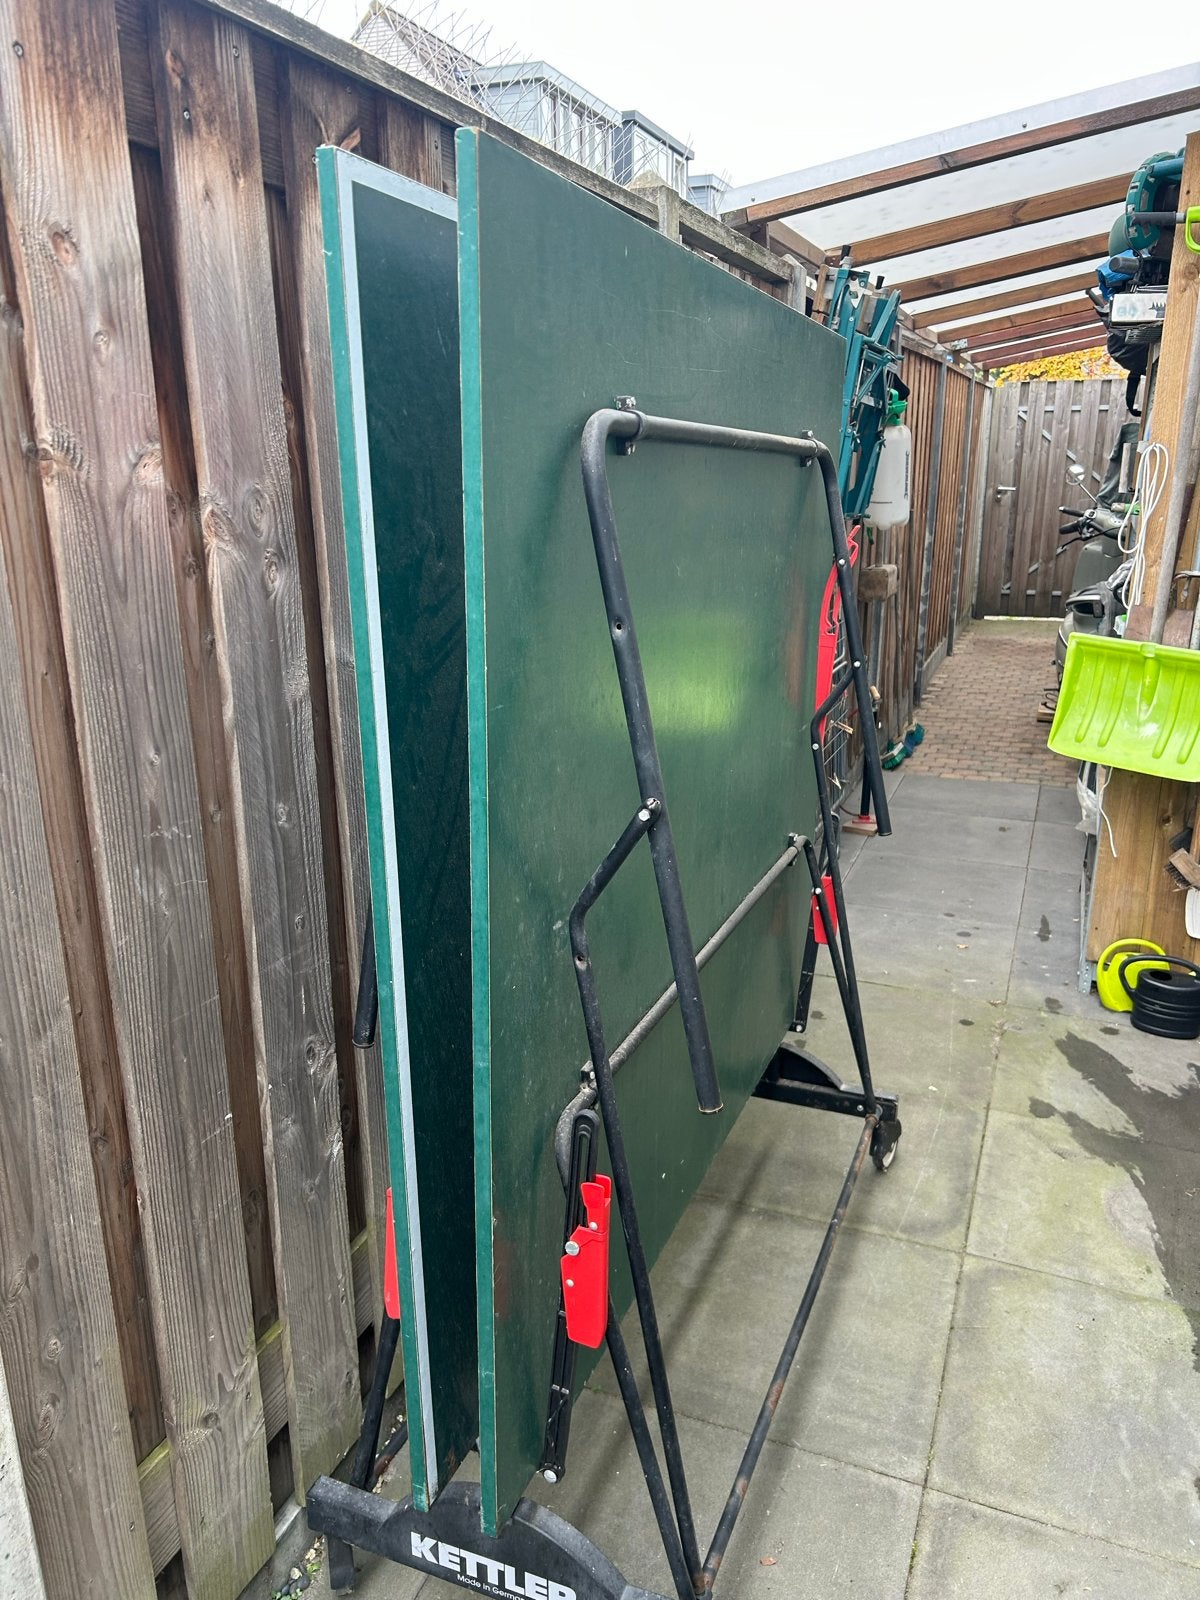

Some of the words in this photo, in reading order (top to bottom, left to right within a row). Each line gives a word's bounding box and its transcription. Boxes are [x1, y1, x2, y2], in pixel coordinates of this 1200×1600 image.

[457, 1573, 481, 1588] Made
[482, 1582, 491, 1592] in
[492, 1587, 525, 1600] Germa
